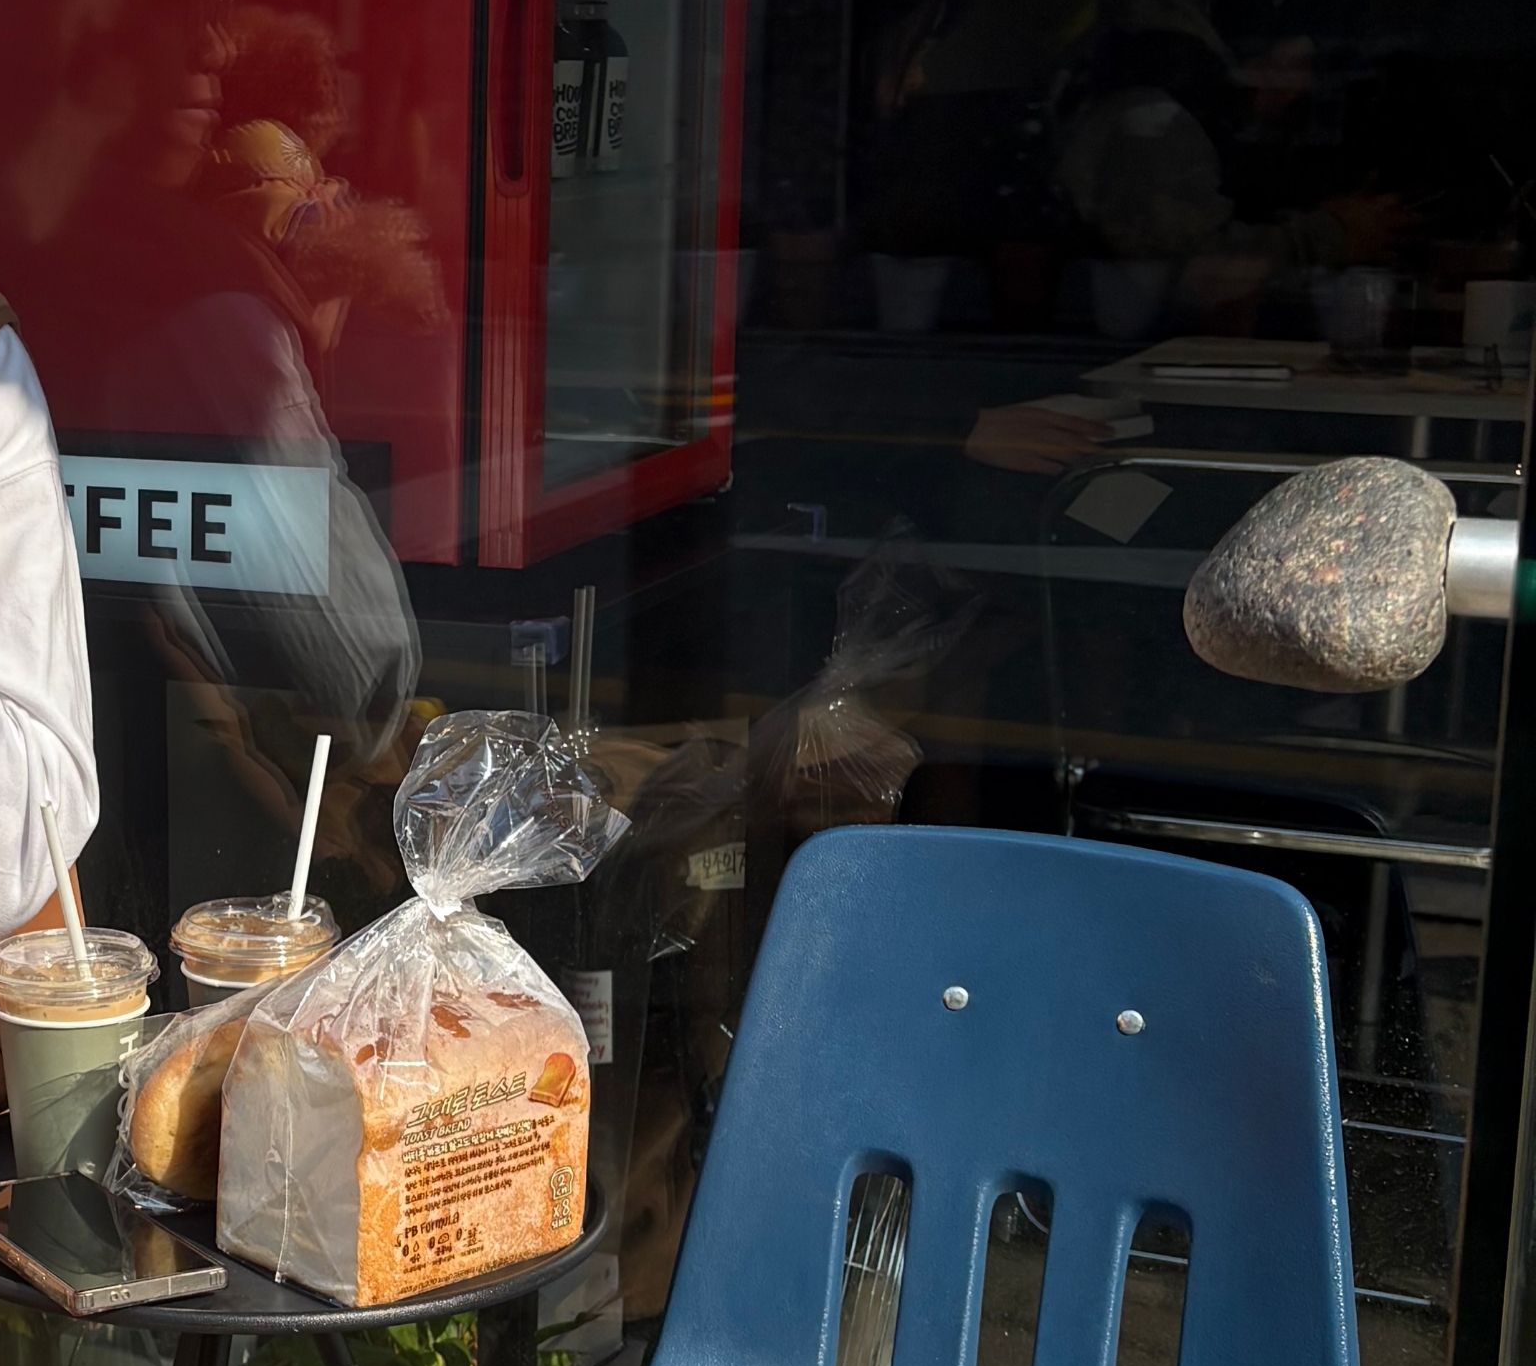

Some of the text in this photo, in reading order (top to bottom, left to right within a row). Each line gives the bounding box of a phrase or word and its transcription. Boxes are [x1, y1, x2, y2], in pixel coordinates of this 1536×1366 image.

[556, 83, 582, 104] HOO
[555, 105, 580, 123] COL
[553, 120, 579, 145] BRE
[65, 484, 233, 564] FEE
[406, 1072, 527, 1128] 그대로 토스트
[402, 1116, 472, 1147] TOAST BREAD
[557, 1173, 566, 1187] 2
[404, 1225, 419, 1239] PB
